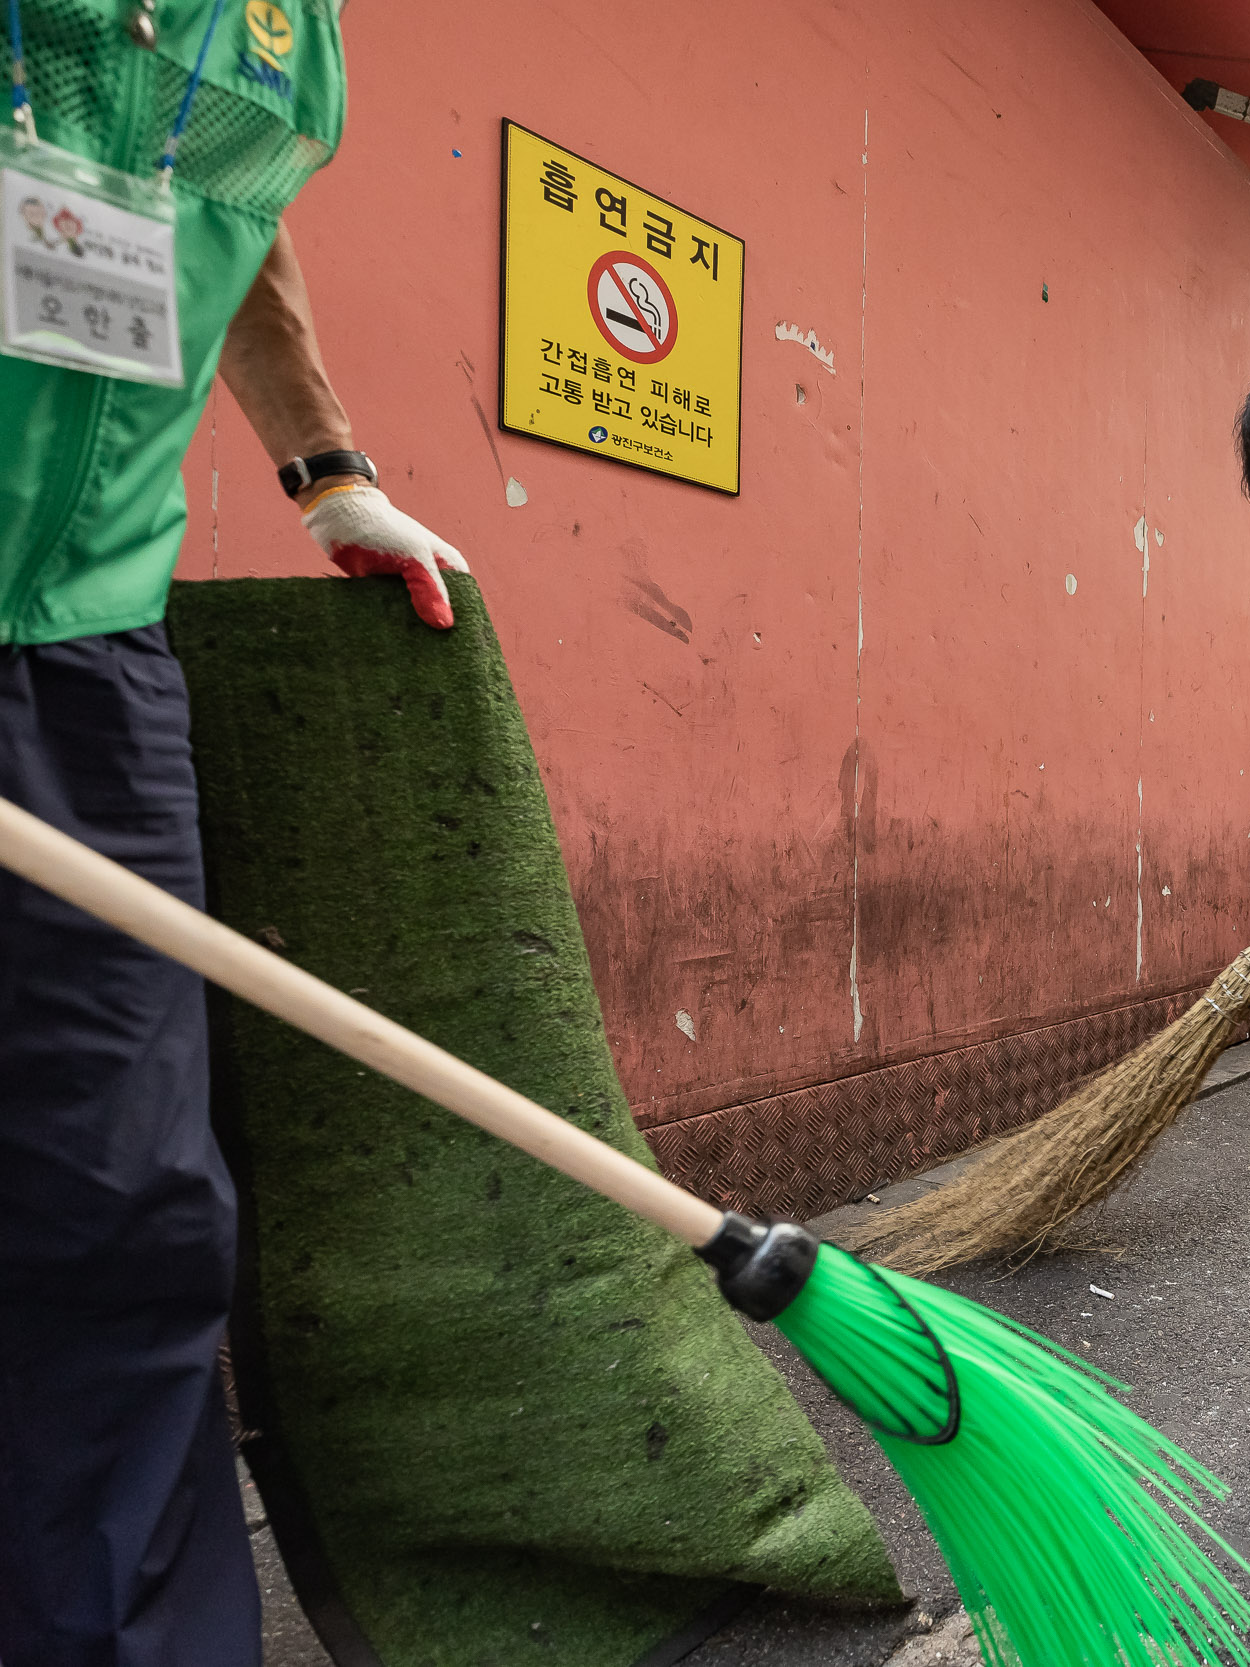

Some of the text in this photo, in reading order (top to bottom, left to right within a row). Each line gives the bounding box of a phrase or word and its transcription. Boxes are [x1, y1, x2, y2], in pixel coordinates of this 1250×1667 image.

[539, 372, 713, 448] 고통 받고 있습니다
[540, 338, 712, 417] 간접흡연 피해로
[611, 433, 674, 462] 광진구보건소
